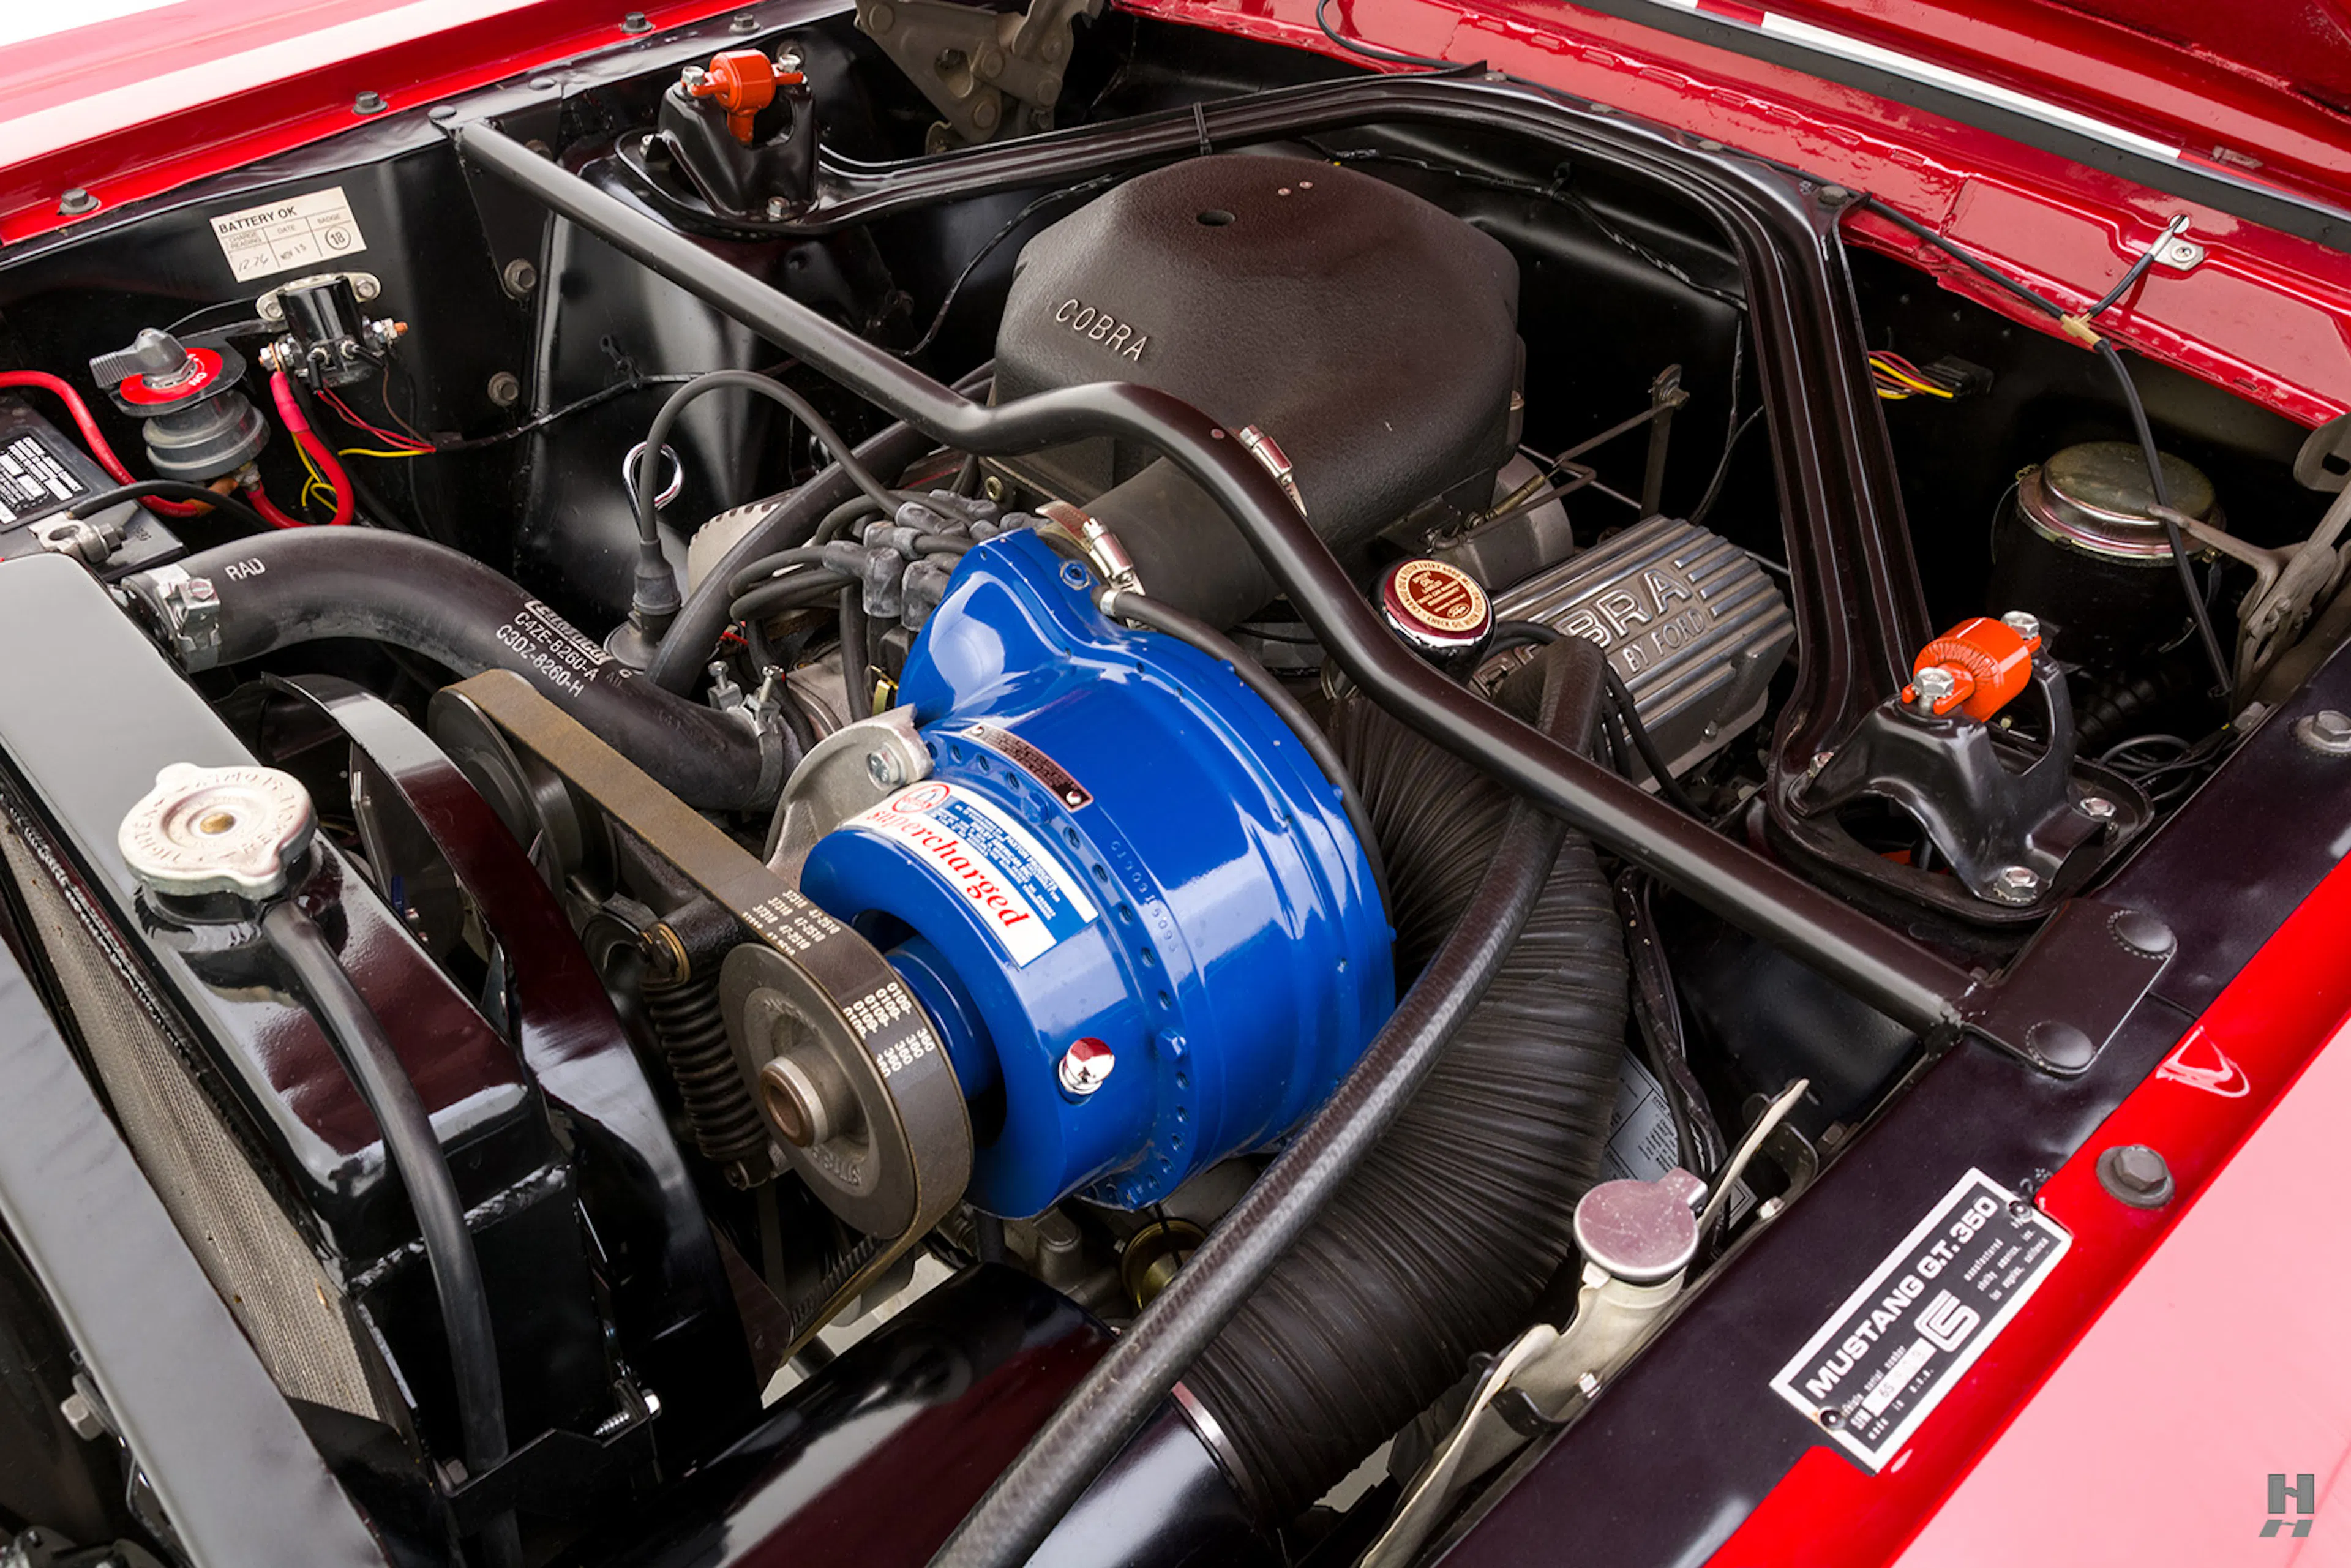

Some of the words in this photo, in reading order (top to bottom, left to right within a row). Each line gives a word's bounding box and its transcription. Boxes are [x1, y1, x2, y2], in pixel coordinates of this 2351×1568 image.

[219, 212, 275, 234] BATTERY
[278, 206, 298, 219] OK
[277, 225, 296, 234] DATE
[331, 232, 345, 245] 18
[1055, 297, 1152, 362] COBRA
[225, 557, 266, 583] RAD
[496, 624, 584, 698] C3DZ-8260-H
[514, 612, 600, 683] C4ZE-8260-A
[1621, 640, 1652, 675] BY
[1654, 607, 1707, 659] FORD
[866, 810, 1030, 928] supercharged
[883, 1047, 902, 1072] 360
[894, 1040, 913, 1065] 360
[906, 1034, 924, 1059] 360
[917, 1027, 936, 1052] 360
[1963, 1237, 2004, 1282] manufactured
[1989, 1289, 2003, 1301] los
[2024, 1237, 2050, 1264] california
[1805, 1273, 1925, 1401] MUSTANG
[1917, 1238, 1960, 1281] G.T.
[1957, 1195, 2000, 1245] 350
[1864, 1368, 1884, 1392] serial
[1884, 1345, 1907, 1370] number
[1867, 1417, 1889, 1441] made
[1892, 1399, 1905, 1411] in
[1908, 1368, 1935, 1394] U.S.A.
